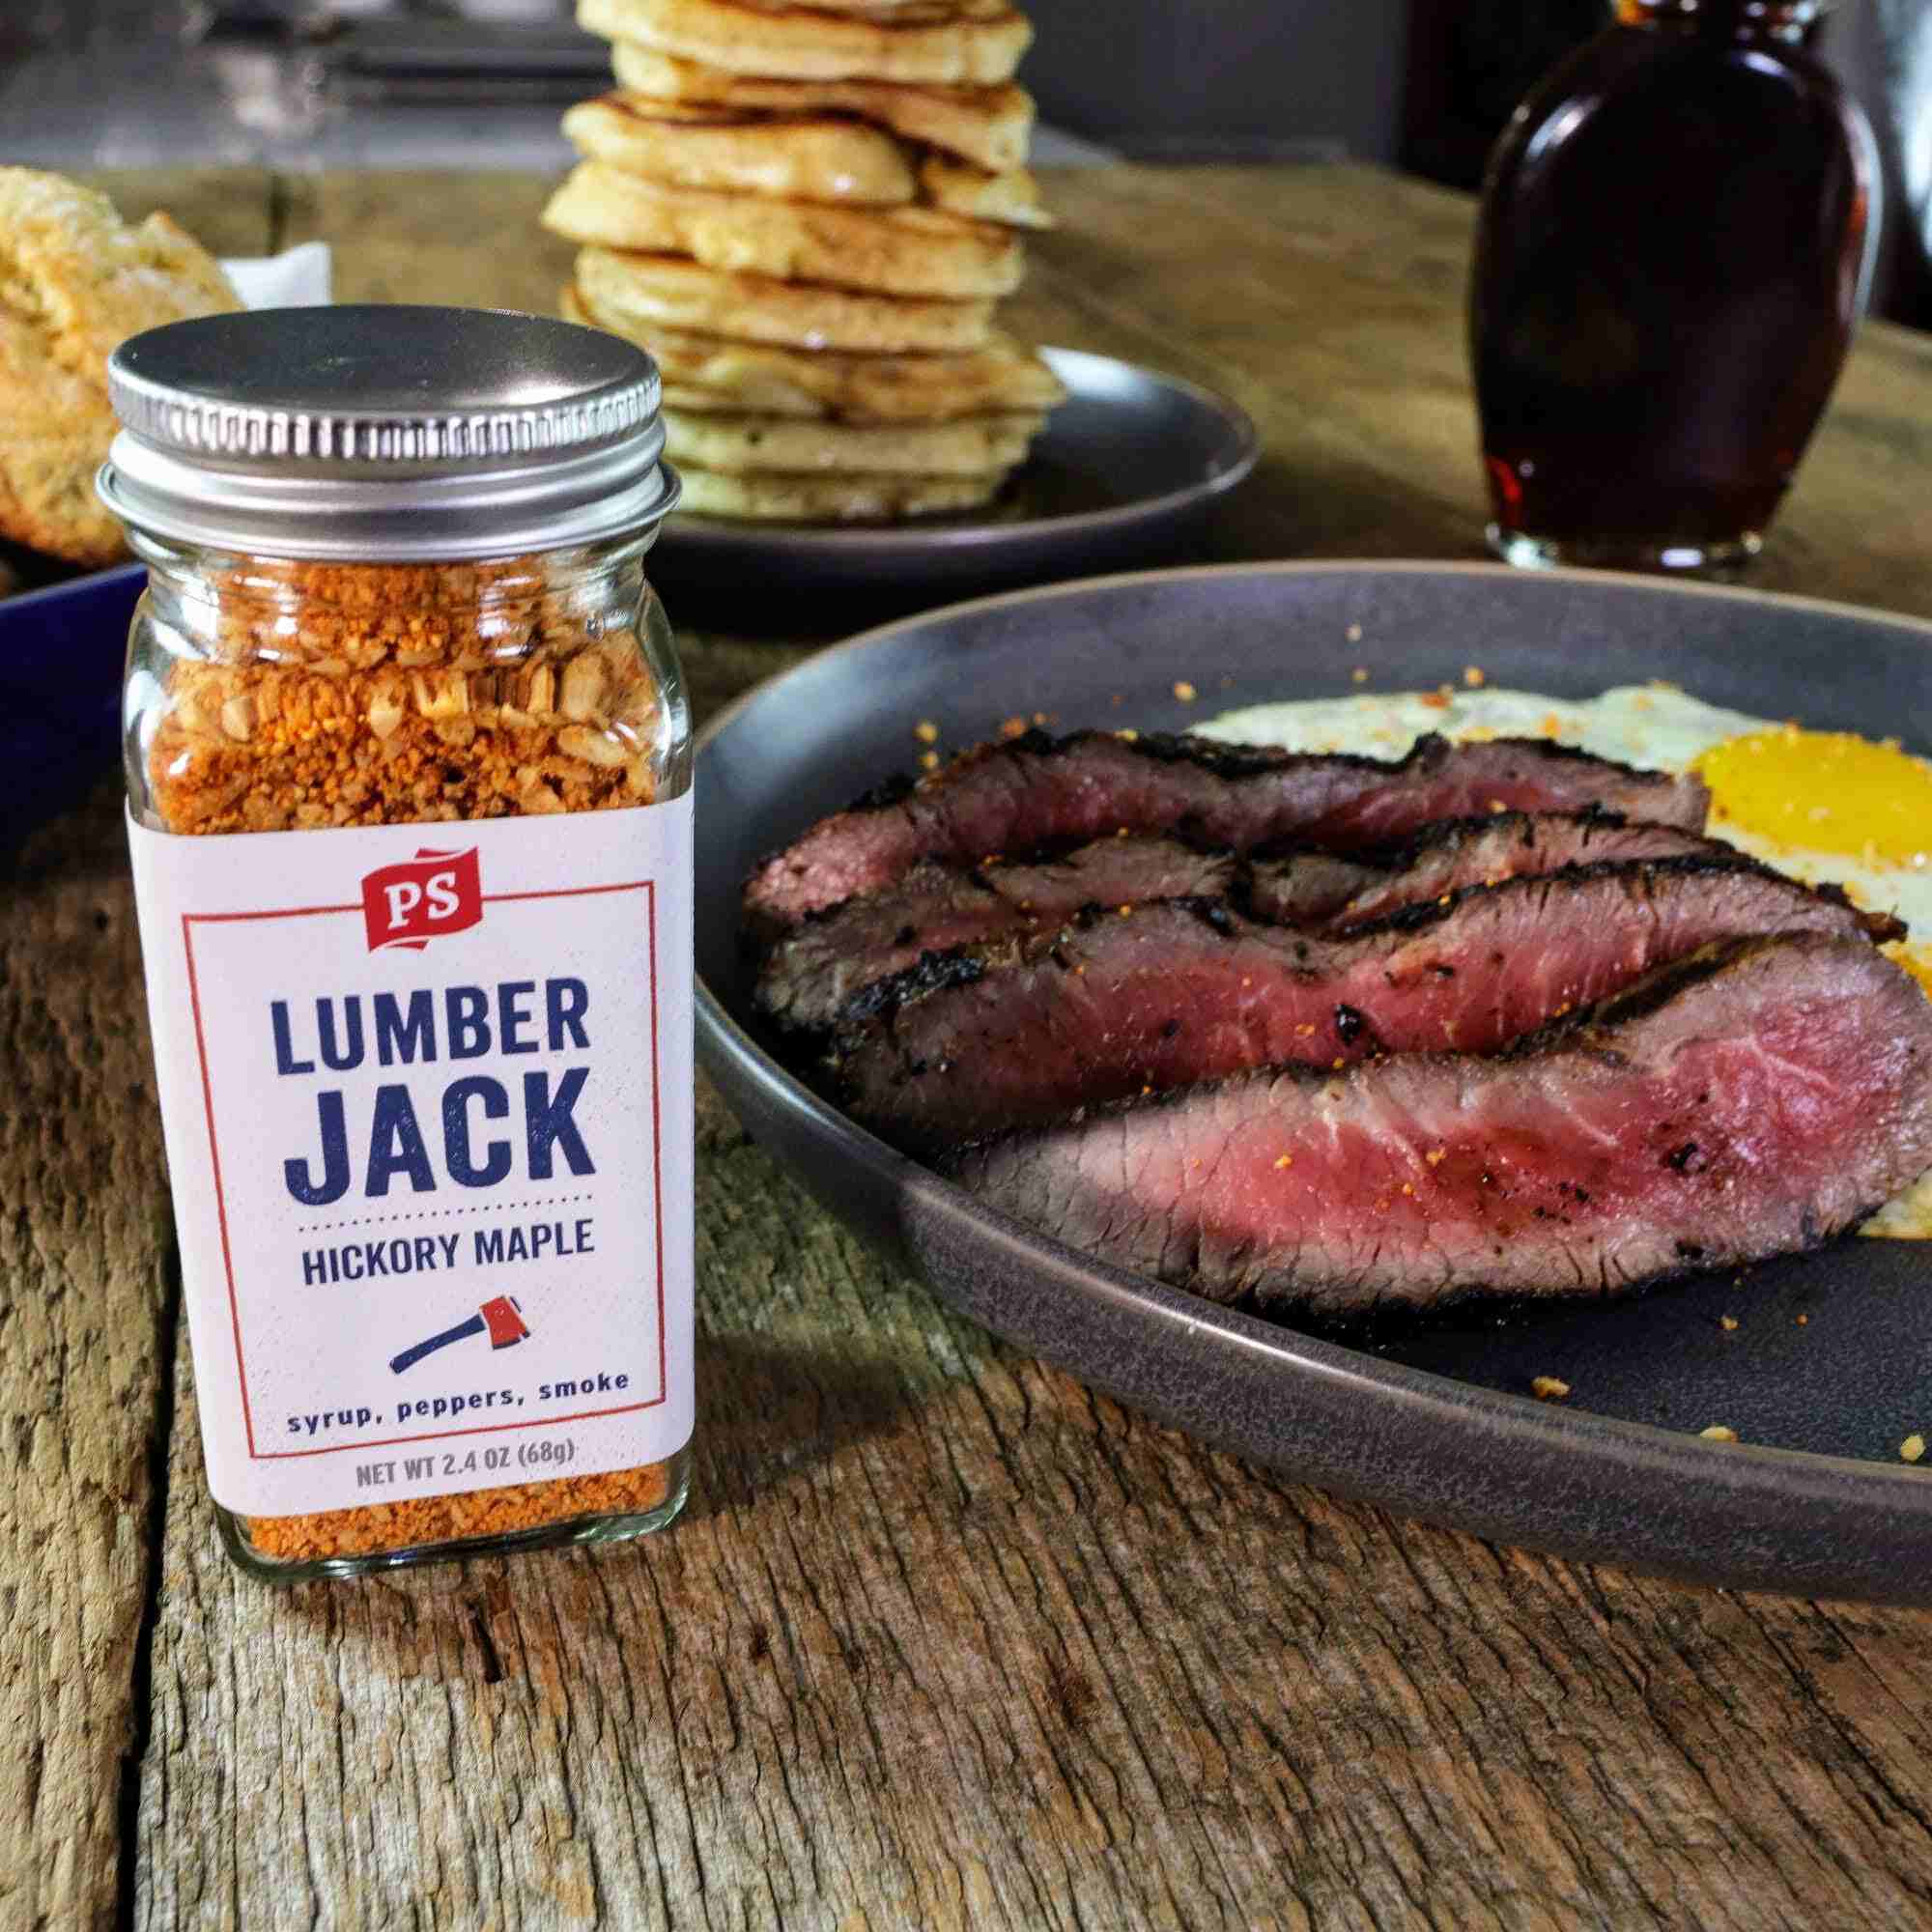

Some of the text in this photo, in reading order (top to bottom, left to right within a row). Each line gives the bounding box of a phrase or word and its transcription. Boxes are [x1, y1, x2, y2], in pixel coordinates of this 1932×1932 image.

[384, 871, 462, 928] PS
[270, 977, 591, 1076] LUMBER
[283, 1066, 597, 1206] JACK
[302, 1218, 596, 1286] HICKORY MAPLE
[287, 1372, 631, 1435] syrup, peppers, smoke
[355, 1437, 577, 1488] NET WT 2.4 OZ (68g)
